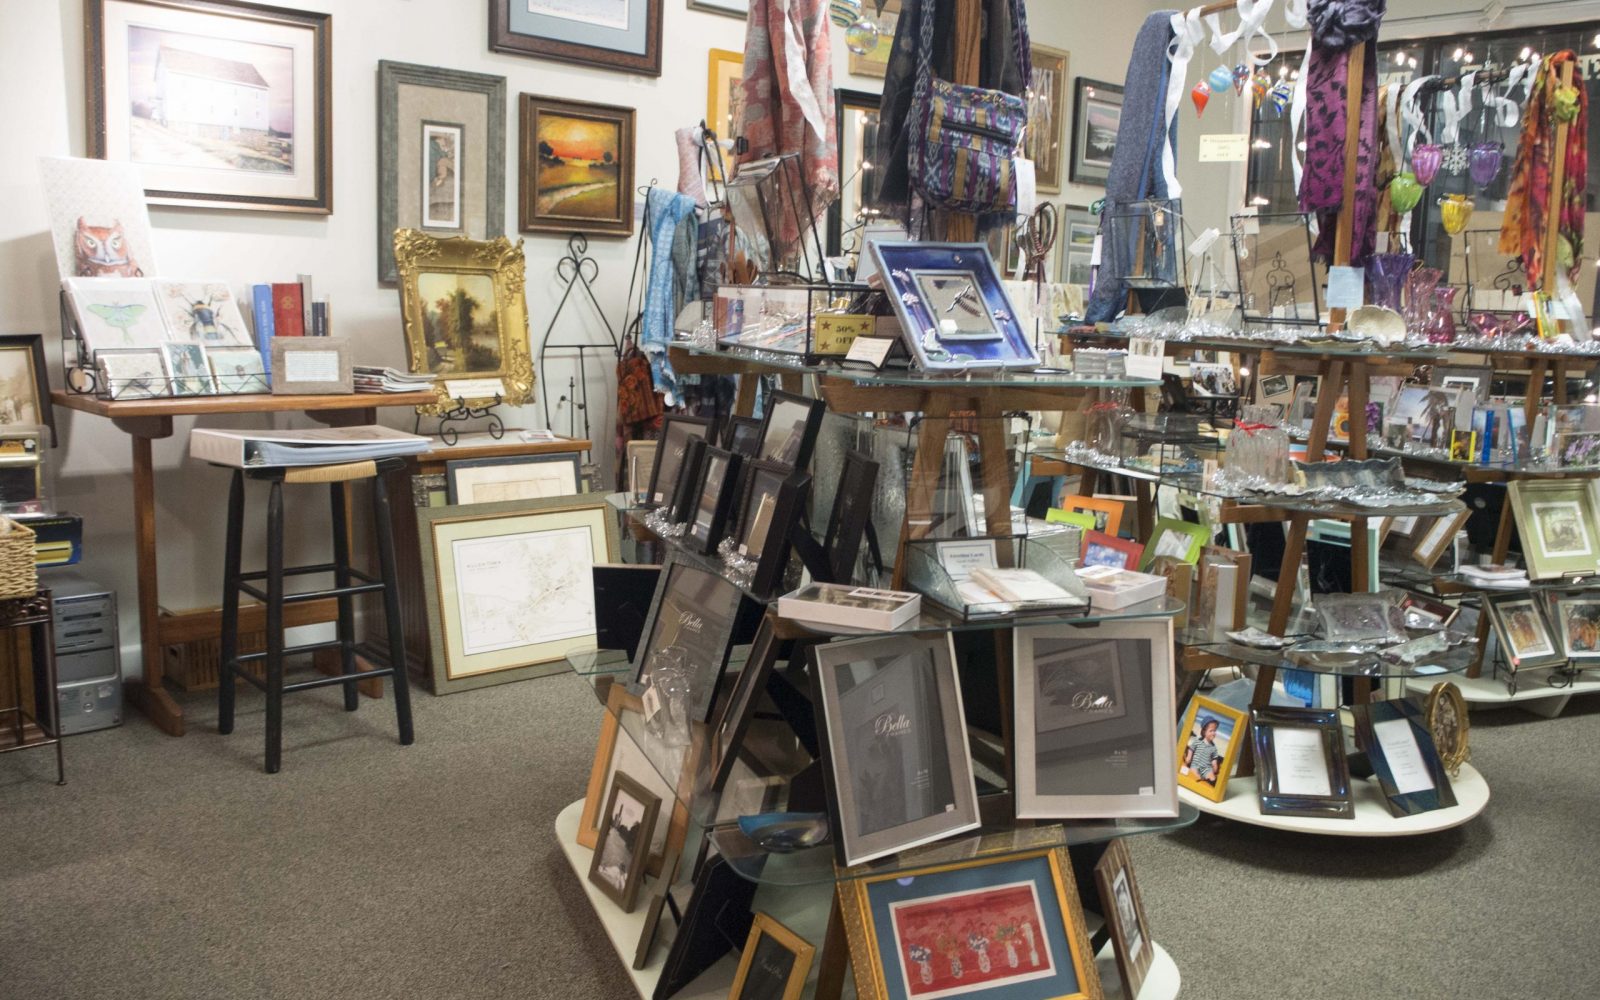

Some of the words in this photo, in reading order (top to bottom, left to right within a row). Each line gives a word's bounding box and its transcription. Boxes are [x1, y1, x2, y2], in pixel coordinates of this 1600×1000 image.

[835, 325, 855, 333] 50%
[678, 611, 703, 629] Bella
[874, 712, 912, 735] Bella
